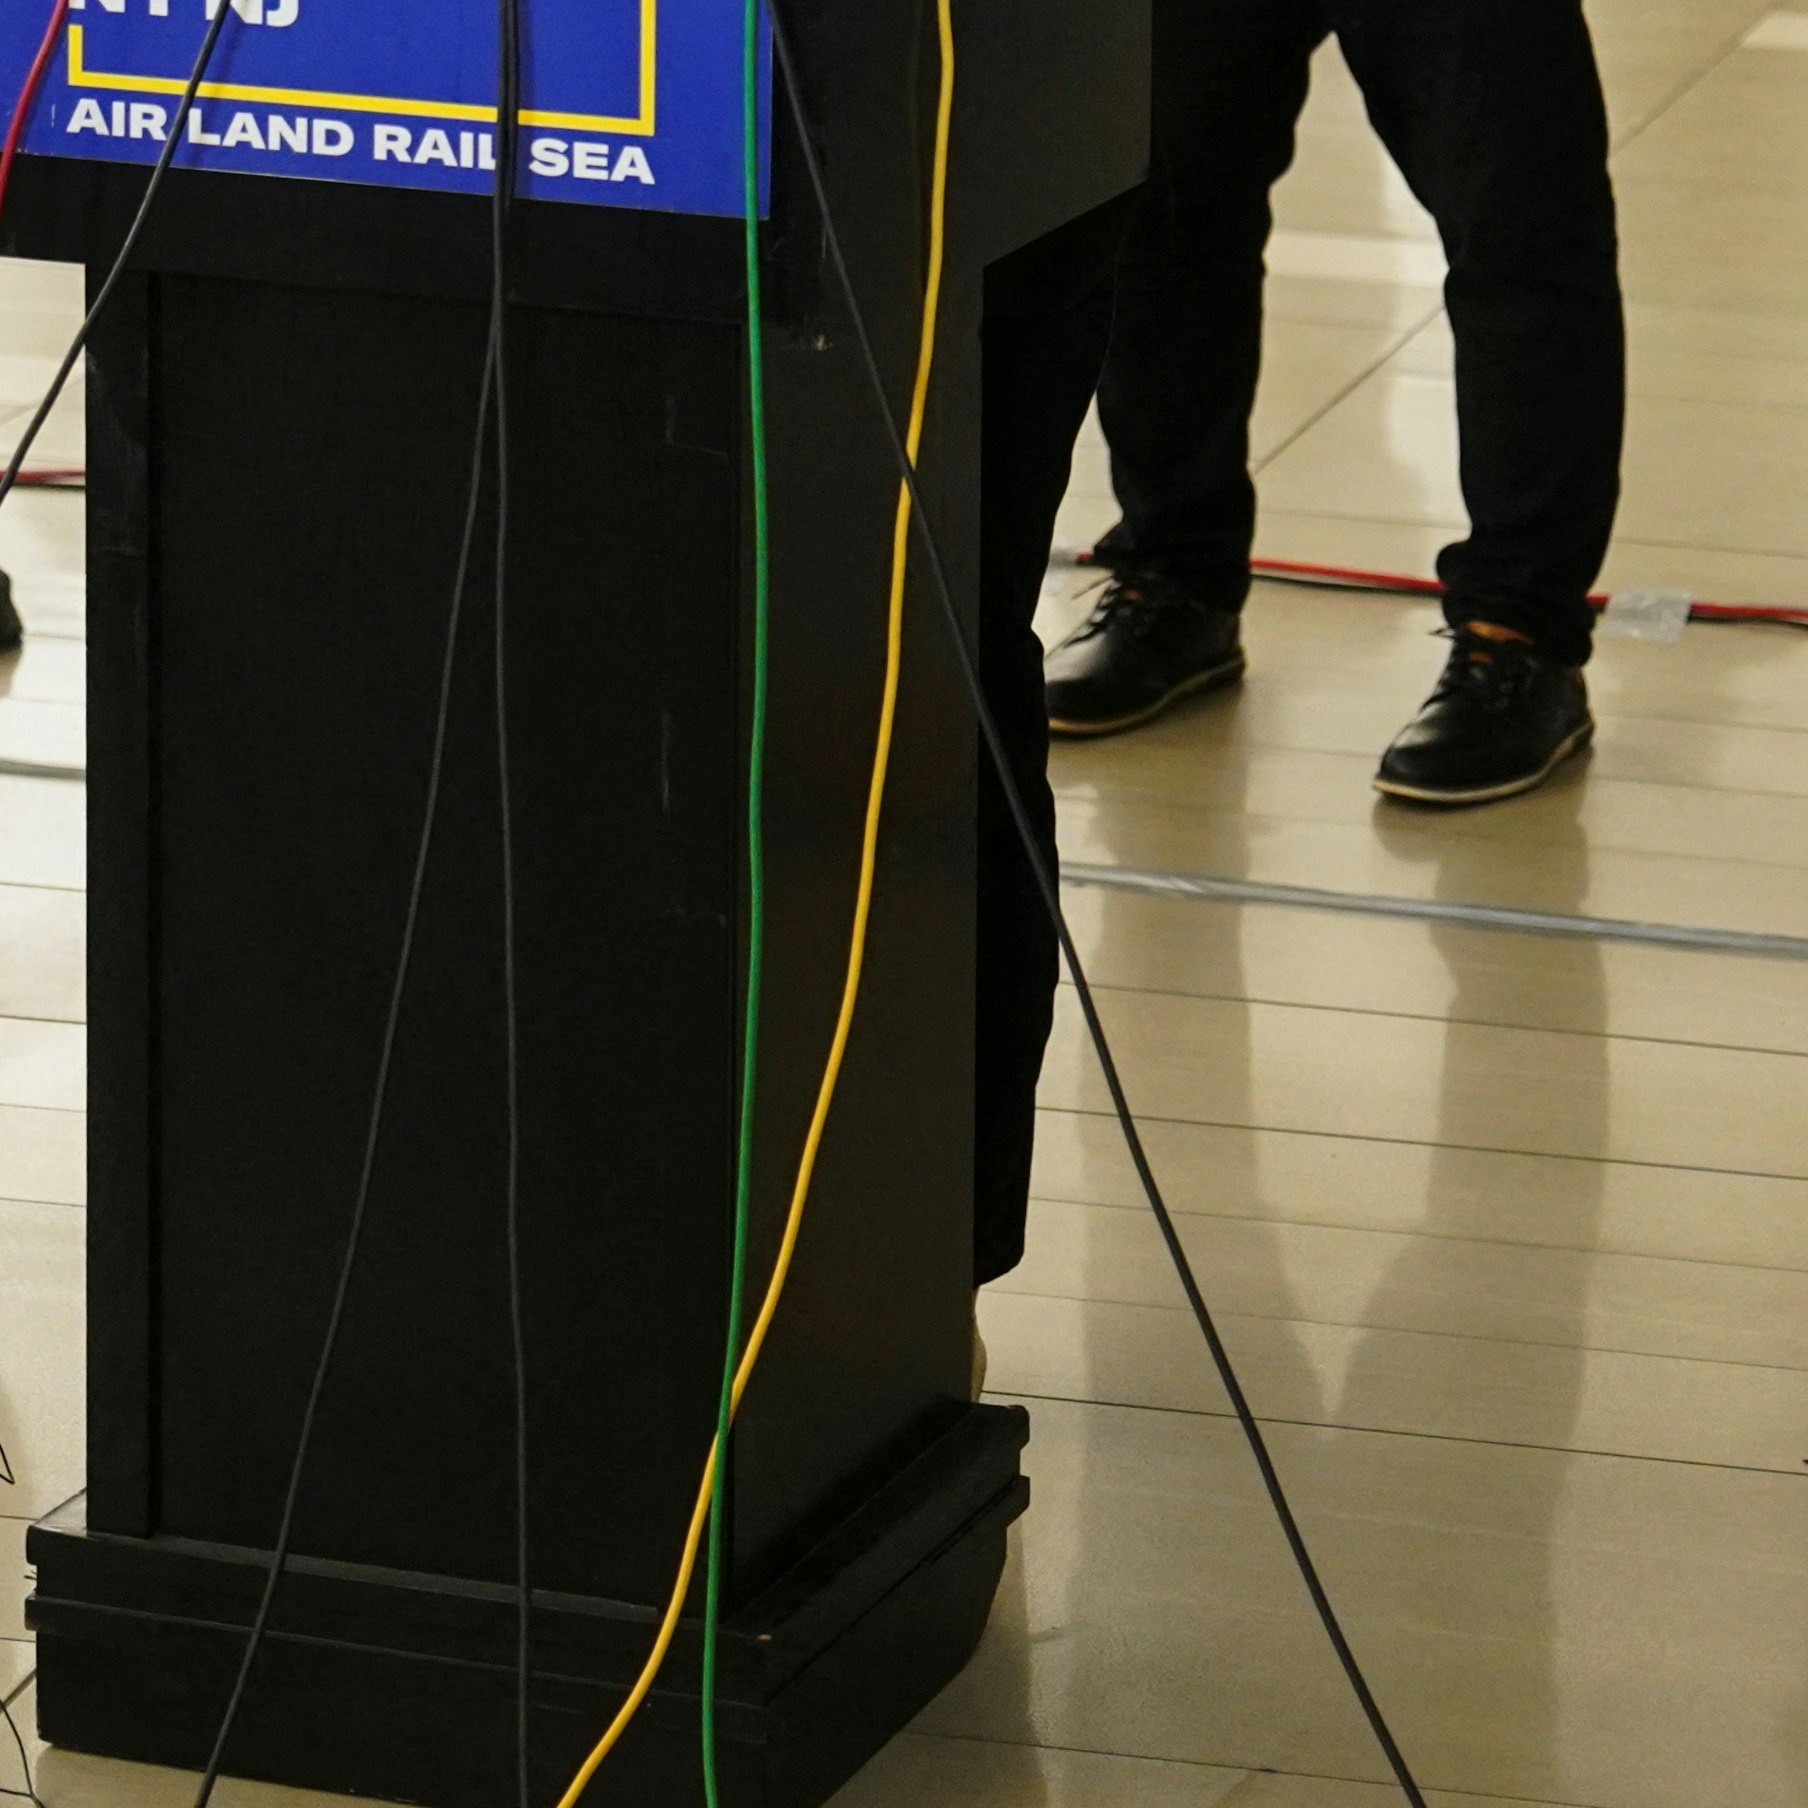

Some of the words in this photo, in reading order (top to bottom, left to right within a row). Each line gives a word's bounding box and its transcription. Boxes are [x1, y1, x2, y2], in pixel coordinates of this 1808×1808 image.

[66, 98, 167, 141] AIR
[188, 108, 354, 156] LAND
[374, 124, 496, 171] RAIL
[529, 137, 655, 185] SEA
